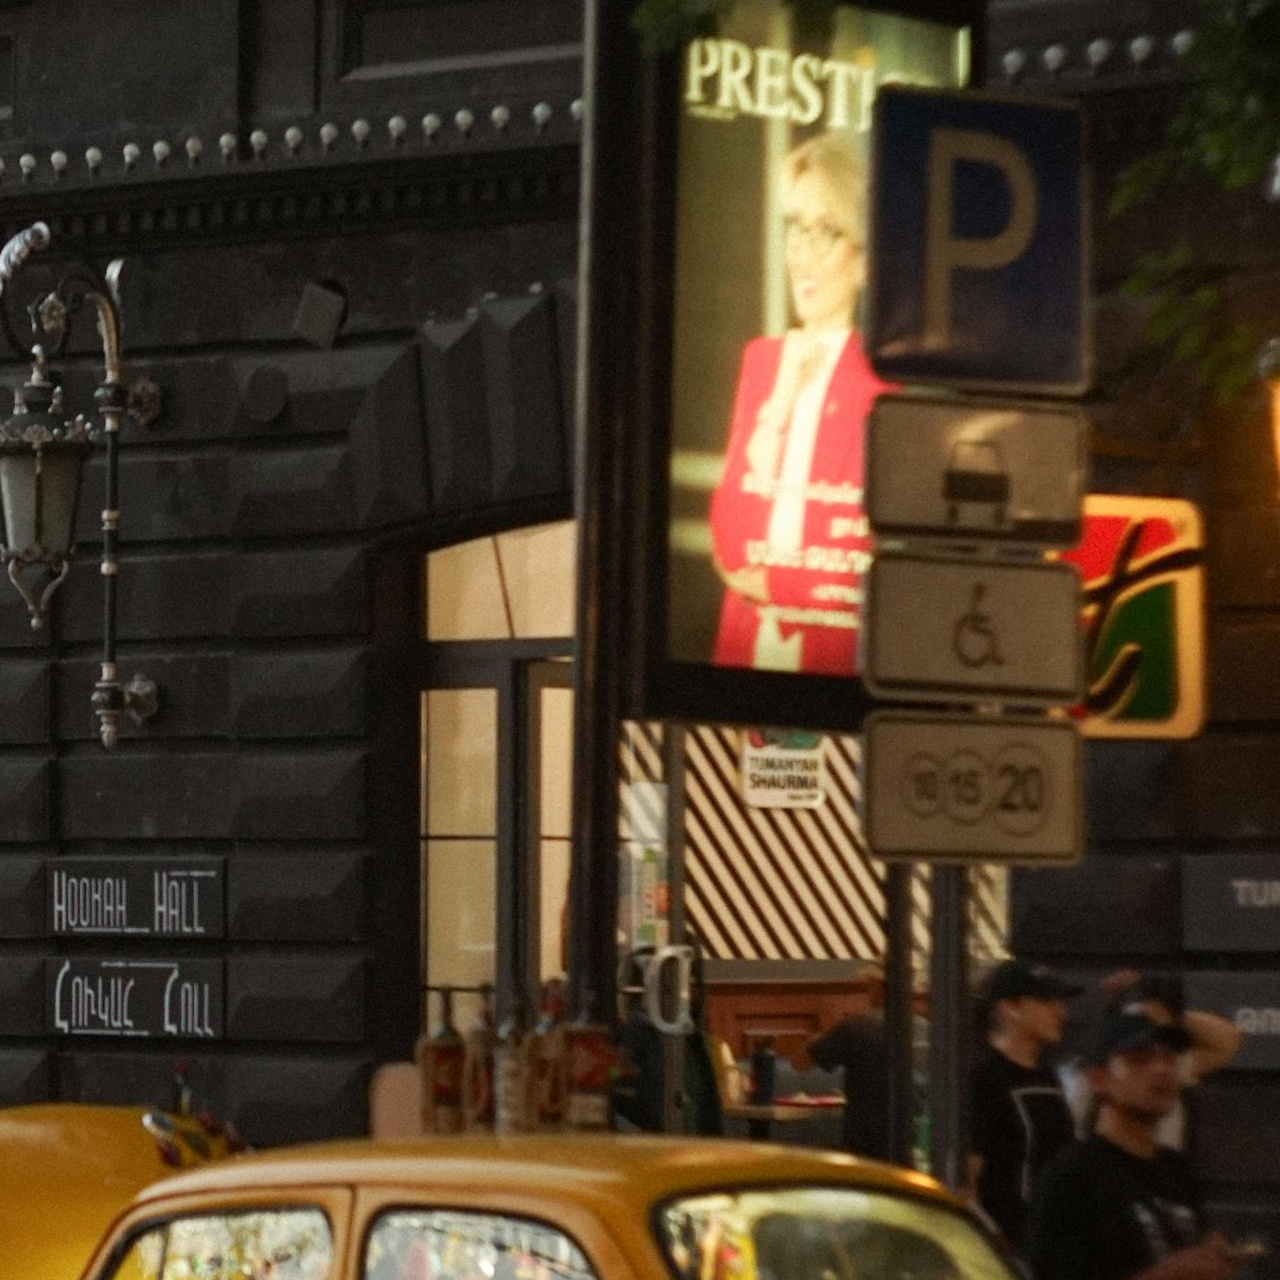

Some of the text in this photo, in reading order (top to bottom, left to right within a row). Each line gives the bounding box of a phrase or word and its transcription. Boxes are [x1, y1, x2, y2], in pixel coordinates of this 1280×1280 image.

[686, 38, 880, 133] PRESTI
[927, 127, 1038, 350] P
[750, 773, 818, 789] SHAURMA
[999, 763, 1044, 811] 20
